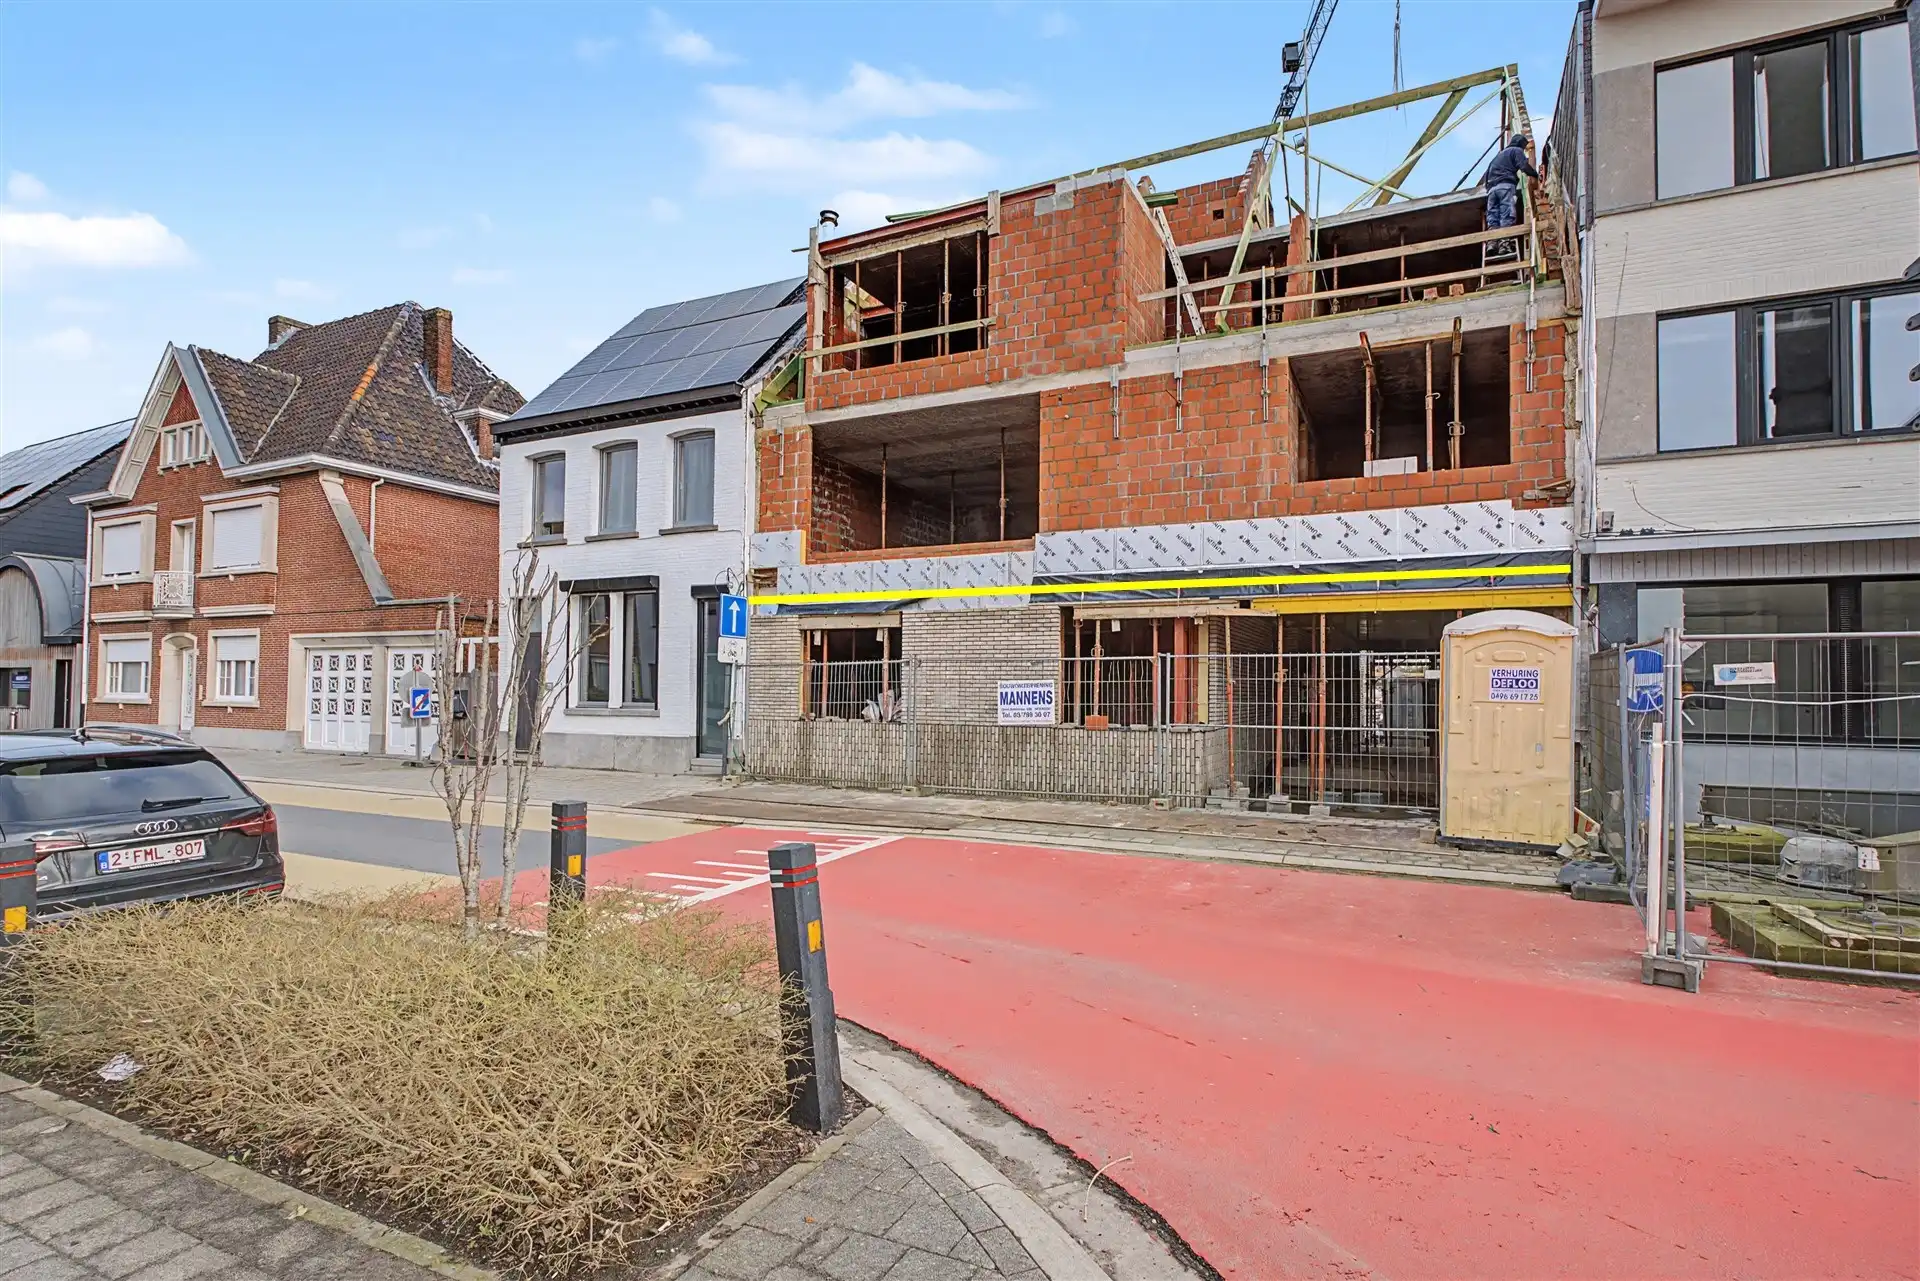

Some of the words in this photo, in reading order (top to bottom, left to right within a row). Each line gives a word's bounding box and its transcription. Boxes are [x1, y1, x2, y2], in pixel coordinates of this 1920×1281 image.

[1478, 502, 1498, 519] UNILIN
[1492, 669, 1538, 677] VERHURING
[1492, 679, 1537, 688] DEFLOO
[1000, 690, 1053, 705] MANNENS
